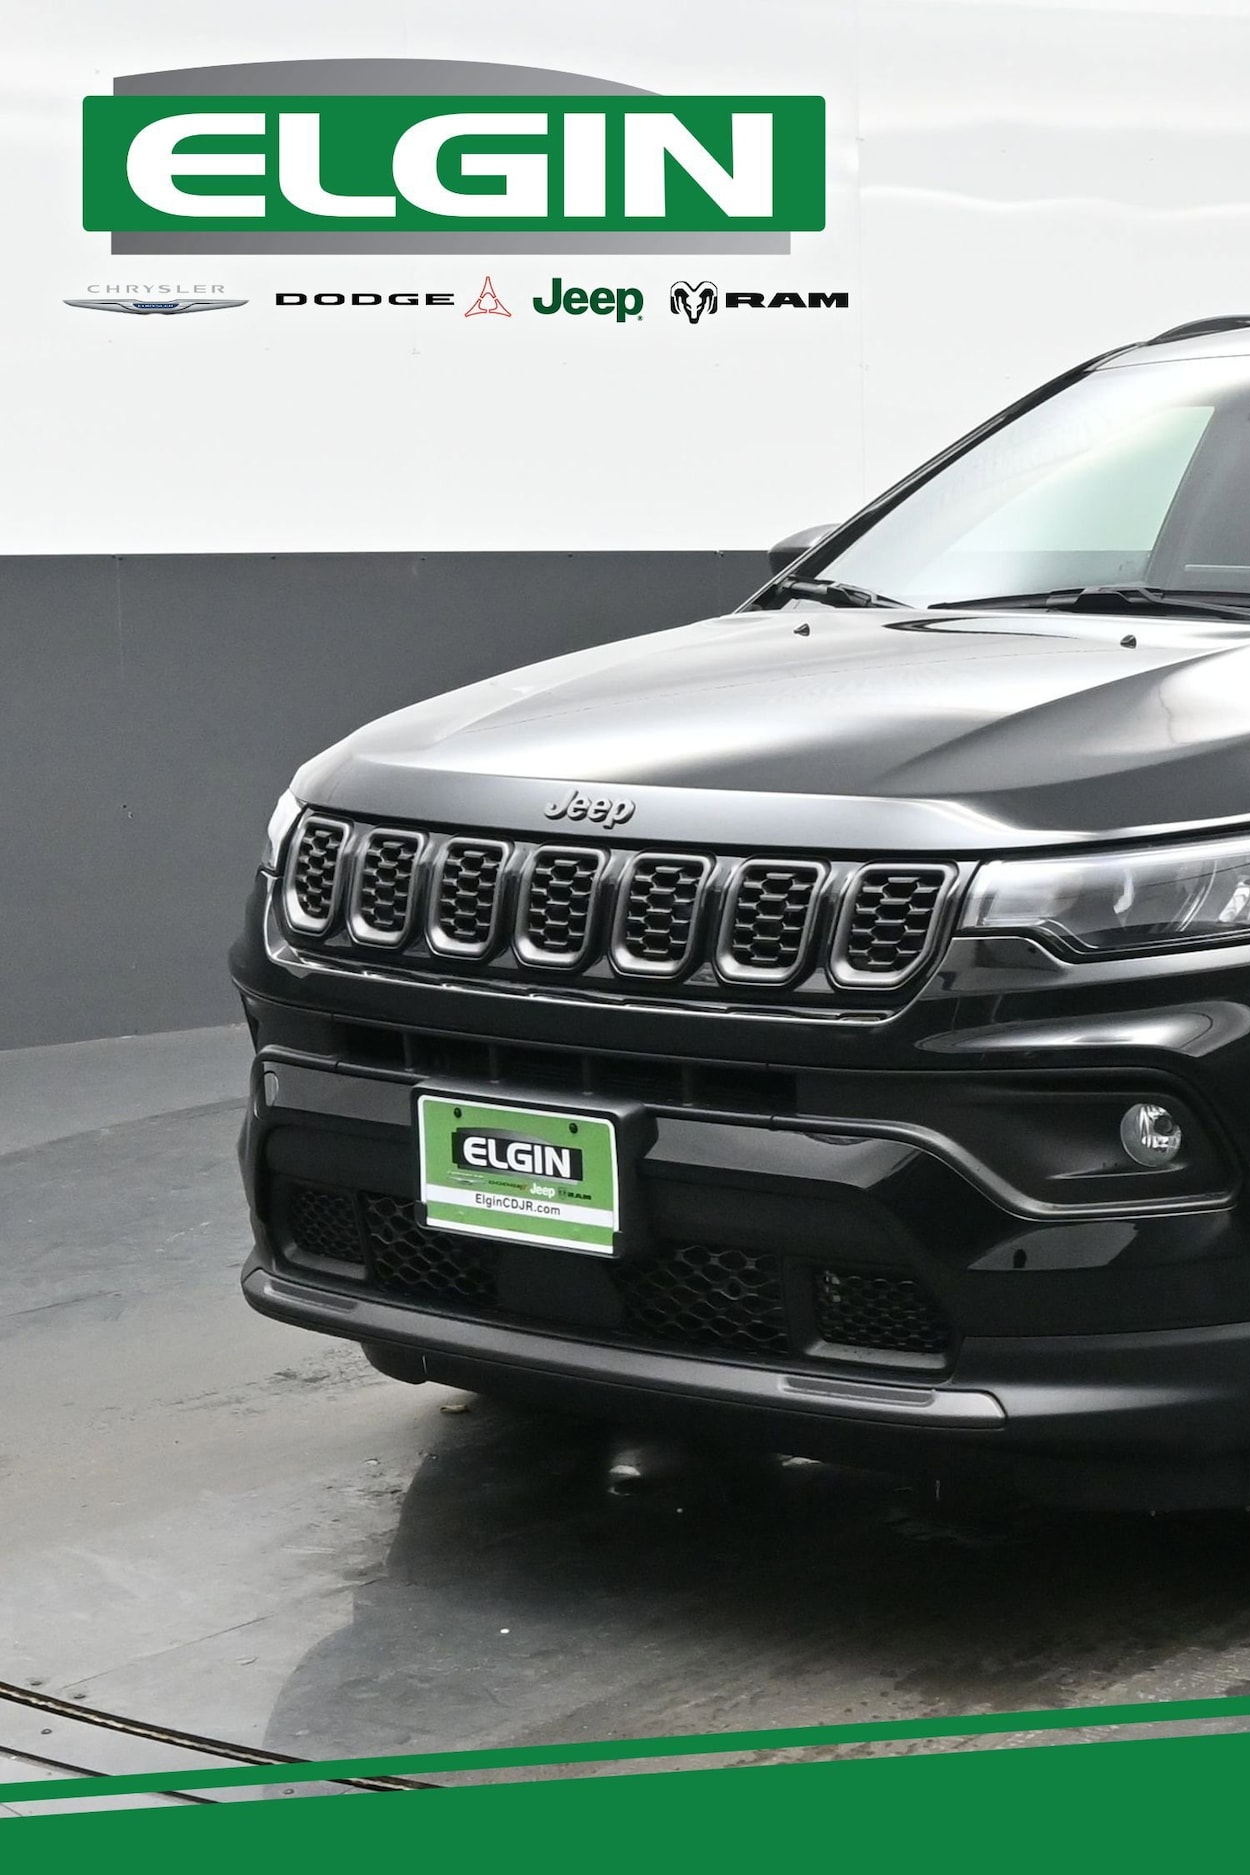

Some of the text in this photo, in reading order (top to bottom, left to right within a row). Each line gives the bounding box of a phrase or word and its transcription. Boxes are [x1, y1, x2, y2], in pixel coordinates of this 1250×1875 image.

[544, 788, 636, 830] Jeep
[463, 1136, 571, 1178] ELGIN
[475, 1193, 561, 1216] ElginCDJR.com
[530, 1182, 556, 1198] Jeep
